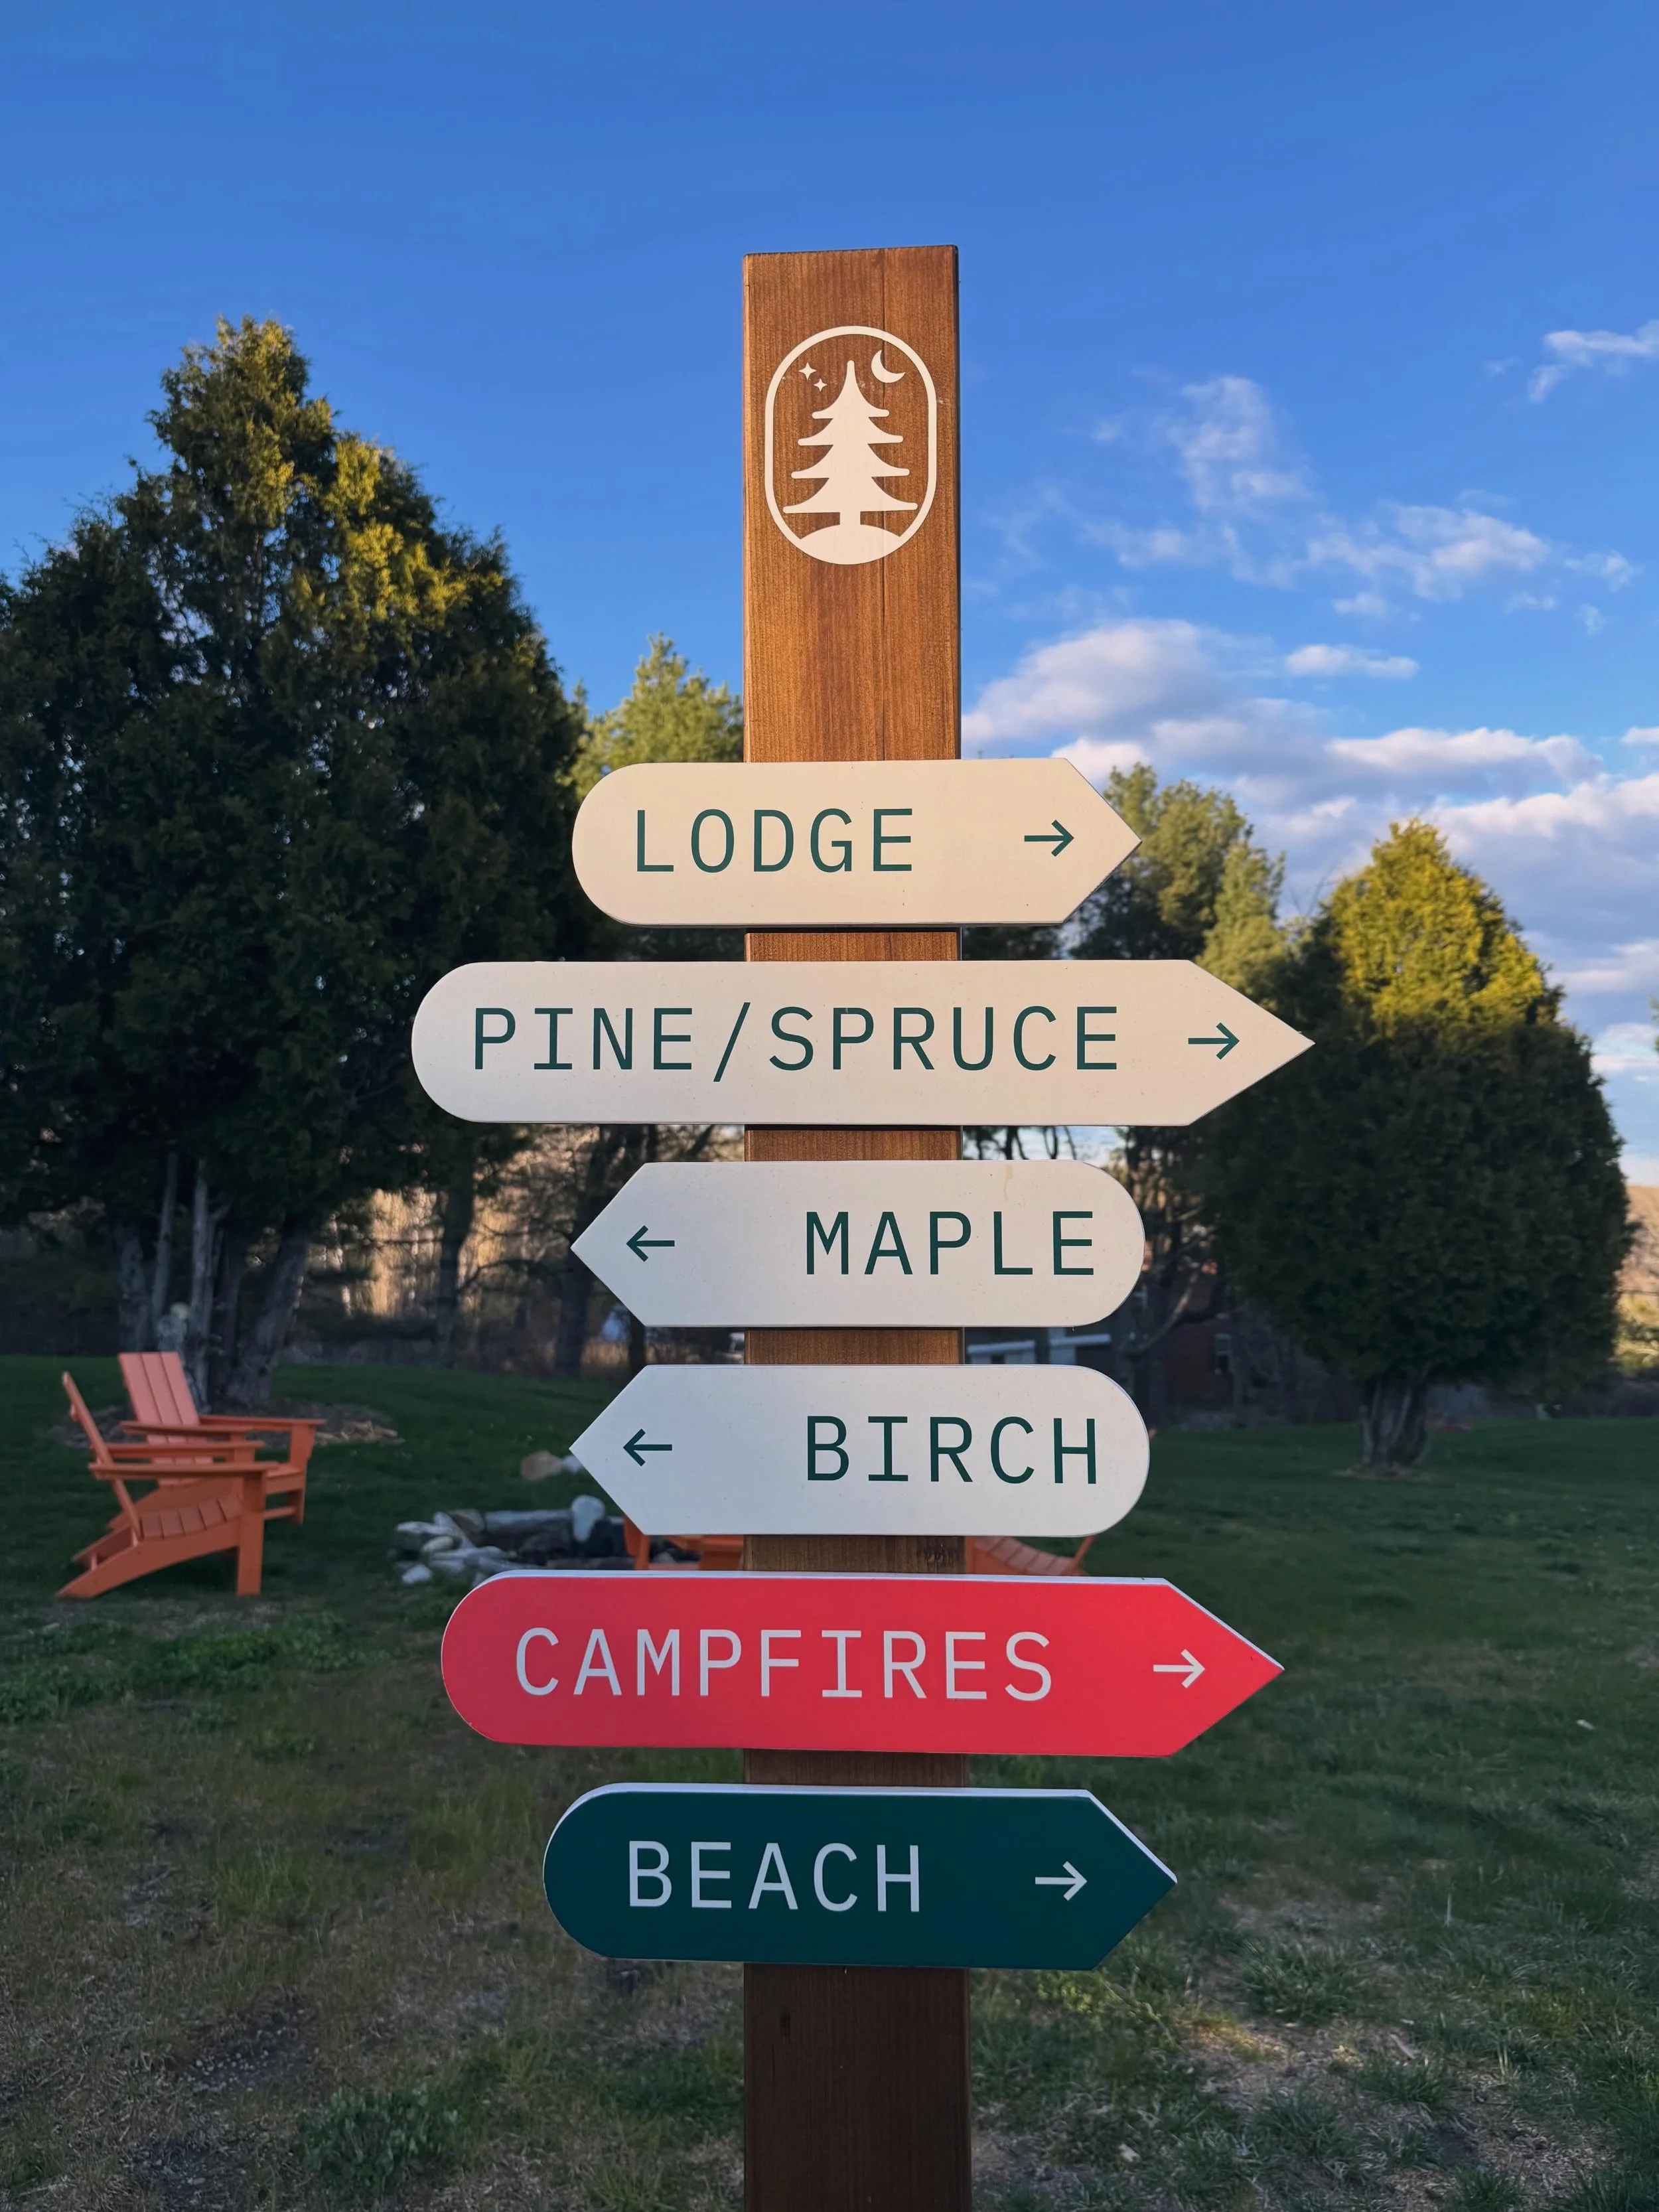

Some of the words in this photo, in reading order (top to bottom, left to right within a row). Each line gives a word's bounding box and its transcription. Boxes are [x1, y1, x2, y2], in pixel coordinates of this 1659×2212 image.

[637, 808, 912, 873] LODGE
[475, 1002, 1116, 1082] PINE/SPRUCE
[807, 1211, 1094, 1275] MAPLE
[808, 1416, 1096, 1484] BIRCH
[516, 1628, 1051, 1701] CAMPFIRES
[630, 1841, 919, 1911] BEACH
